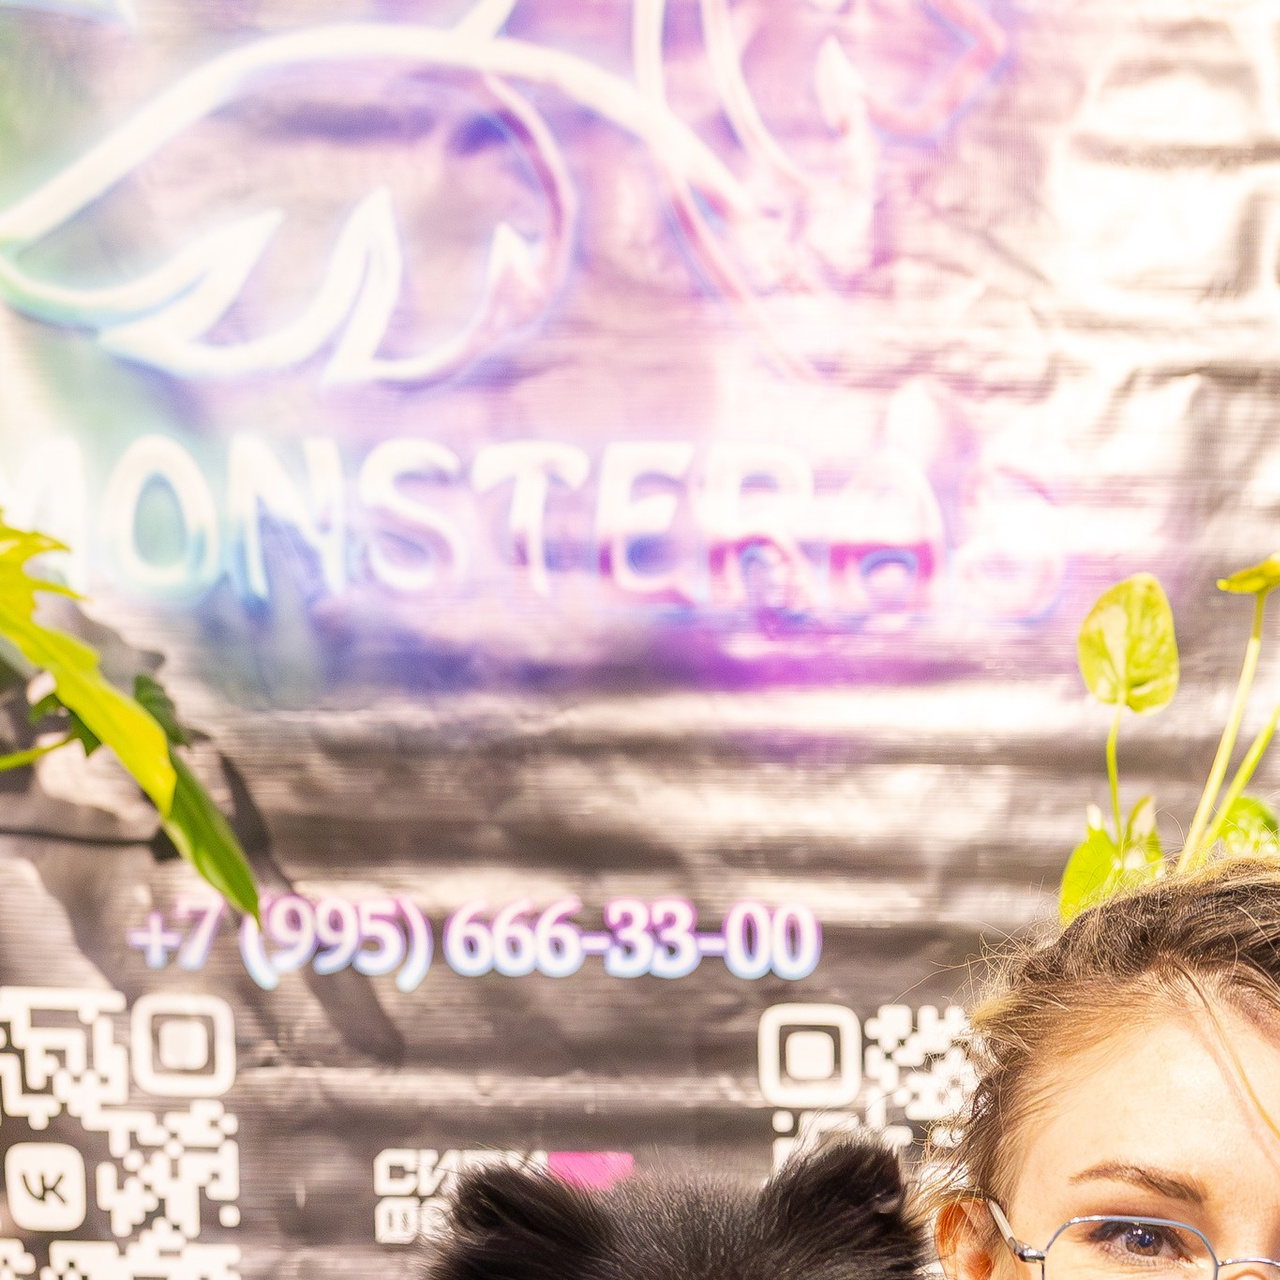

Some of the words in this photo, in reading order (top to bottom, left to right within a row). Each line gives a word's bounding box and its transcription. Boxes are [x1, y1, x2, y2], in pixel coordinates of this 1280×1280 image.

[126, 894, 228, 971] +7
[239, 893, 433, 992] (995)
[442, 897, 822, 980] 666-33-00
